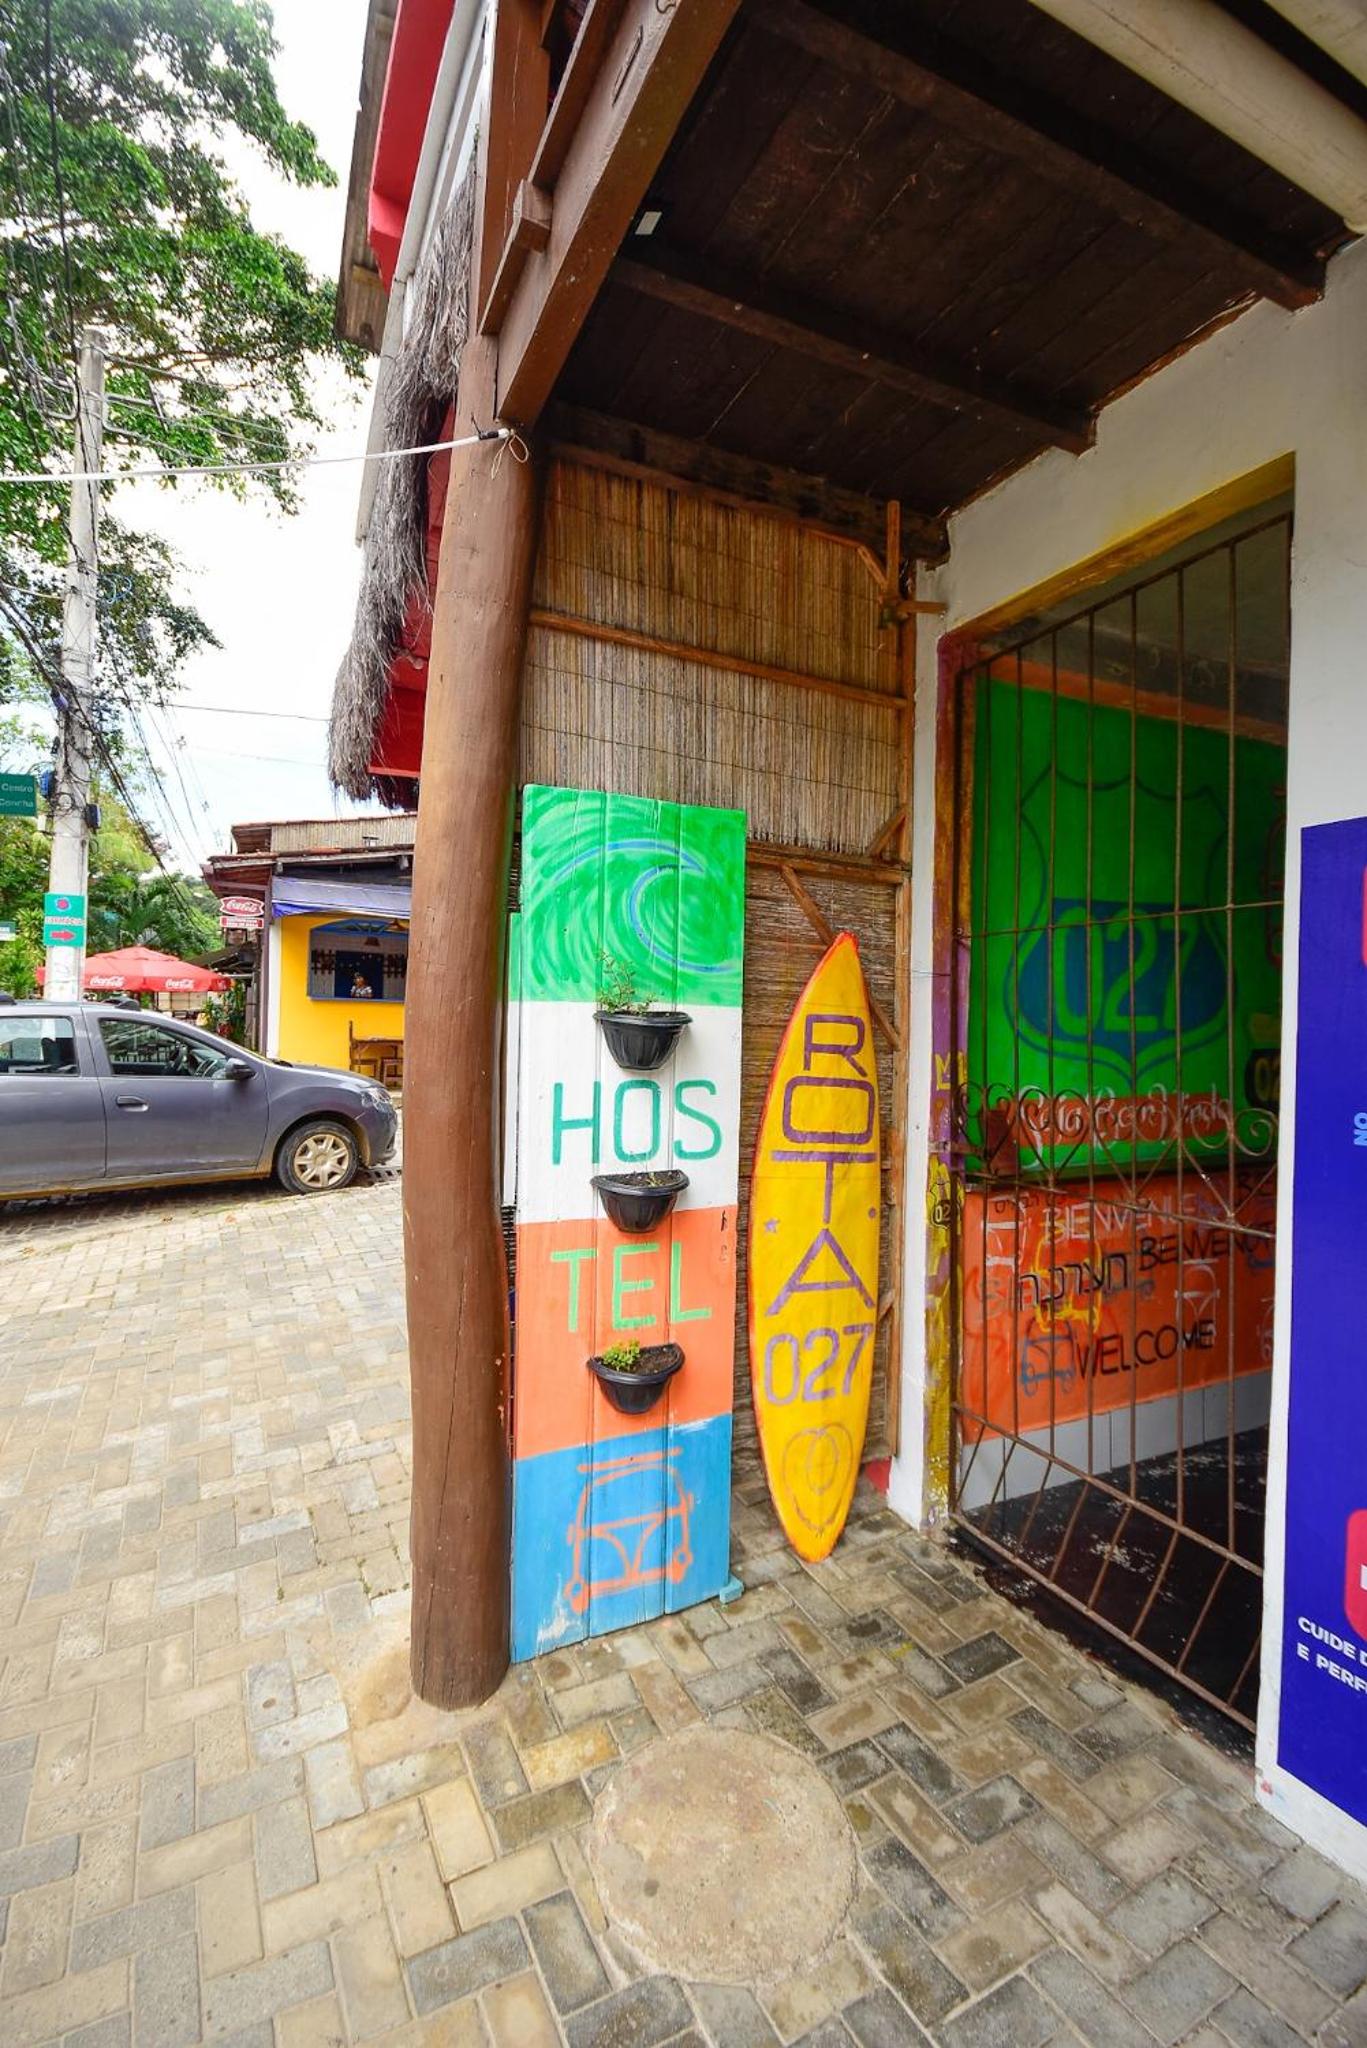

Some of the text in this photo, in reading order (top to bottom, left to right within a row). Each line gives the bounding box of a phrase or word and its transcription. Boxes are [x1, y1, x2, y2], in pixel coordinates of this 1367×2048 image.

[1053, 906, 1198, 1036] 027
[552, 1079, 722, 1165] HOS
[765, 1013, 878, 1317] ROTA
[550, 1241, 713, 1333] TEL
[764, 1323, 874, 1406] 027
[1075, 1319, 1215, 1378] WELCOME
[1297, 1642, 1310, 1661] E
[1298, 1616, 1357, 1661] CUIDE
